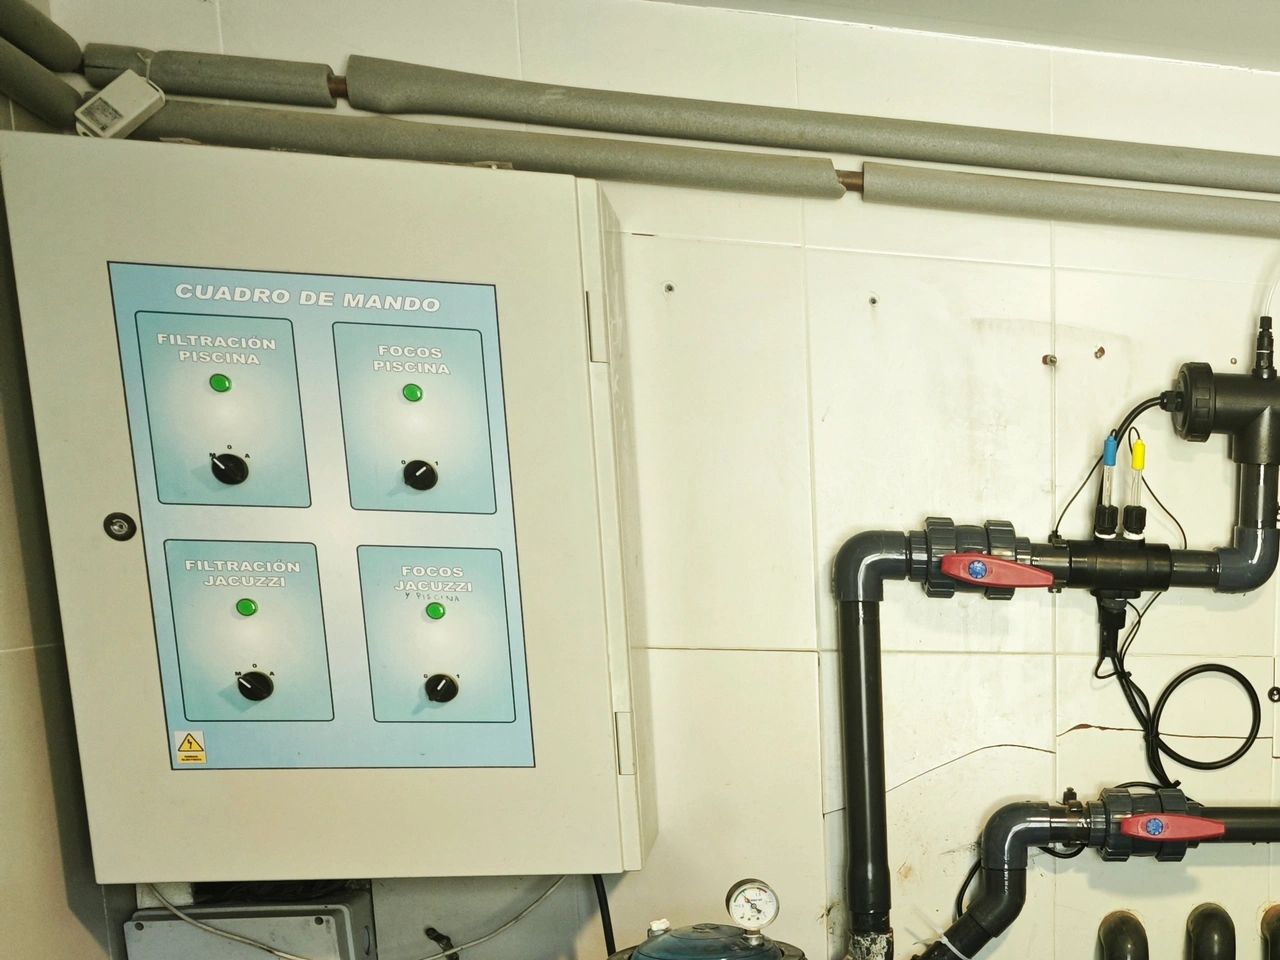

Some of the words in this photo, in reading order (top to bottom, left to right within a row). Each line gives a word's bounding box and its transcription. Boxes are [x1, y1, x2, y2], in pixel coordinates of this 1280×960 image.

[175, 283, 290, 304] CUADRO
[299, 290, 335, 306] DE
[343, 293, 441, 312] MANDO
[157, 333, 276, 350] FILTRACIÓN
[179, 351, 260, 365] PISCINA
[377, 345, 442, 359] FOCOS
[373, 360, 451, 374] PISCINA
[185, 560, 300, 572] FILTRACIÓN
[402, 566, 464, 577] FOCOS
[204, 576, 286, 587] JACUZZI
[394, 580, 472, 592] JACUZZI
